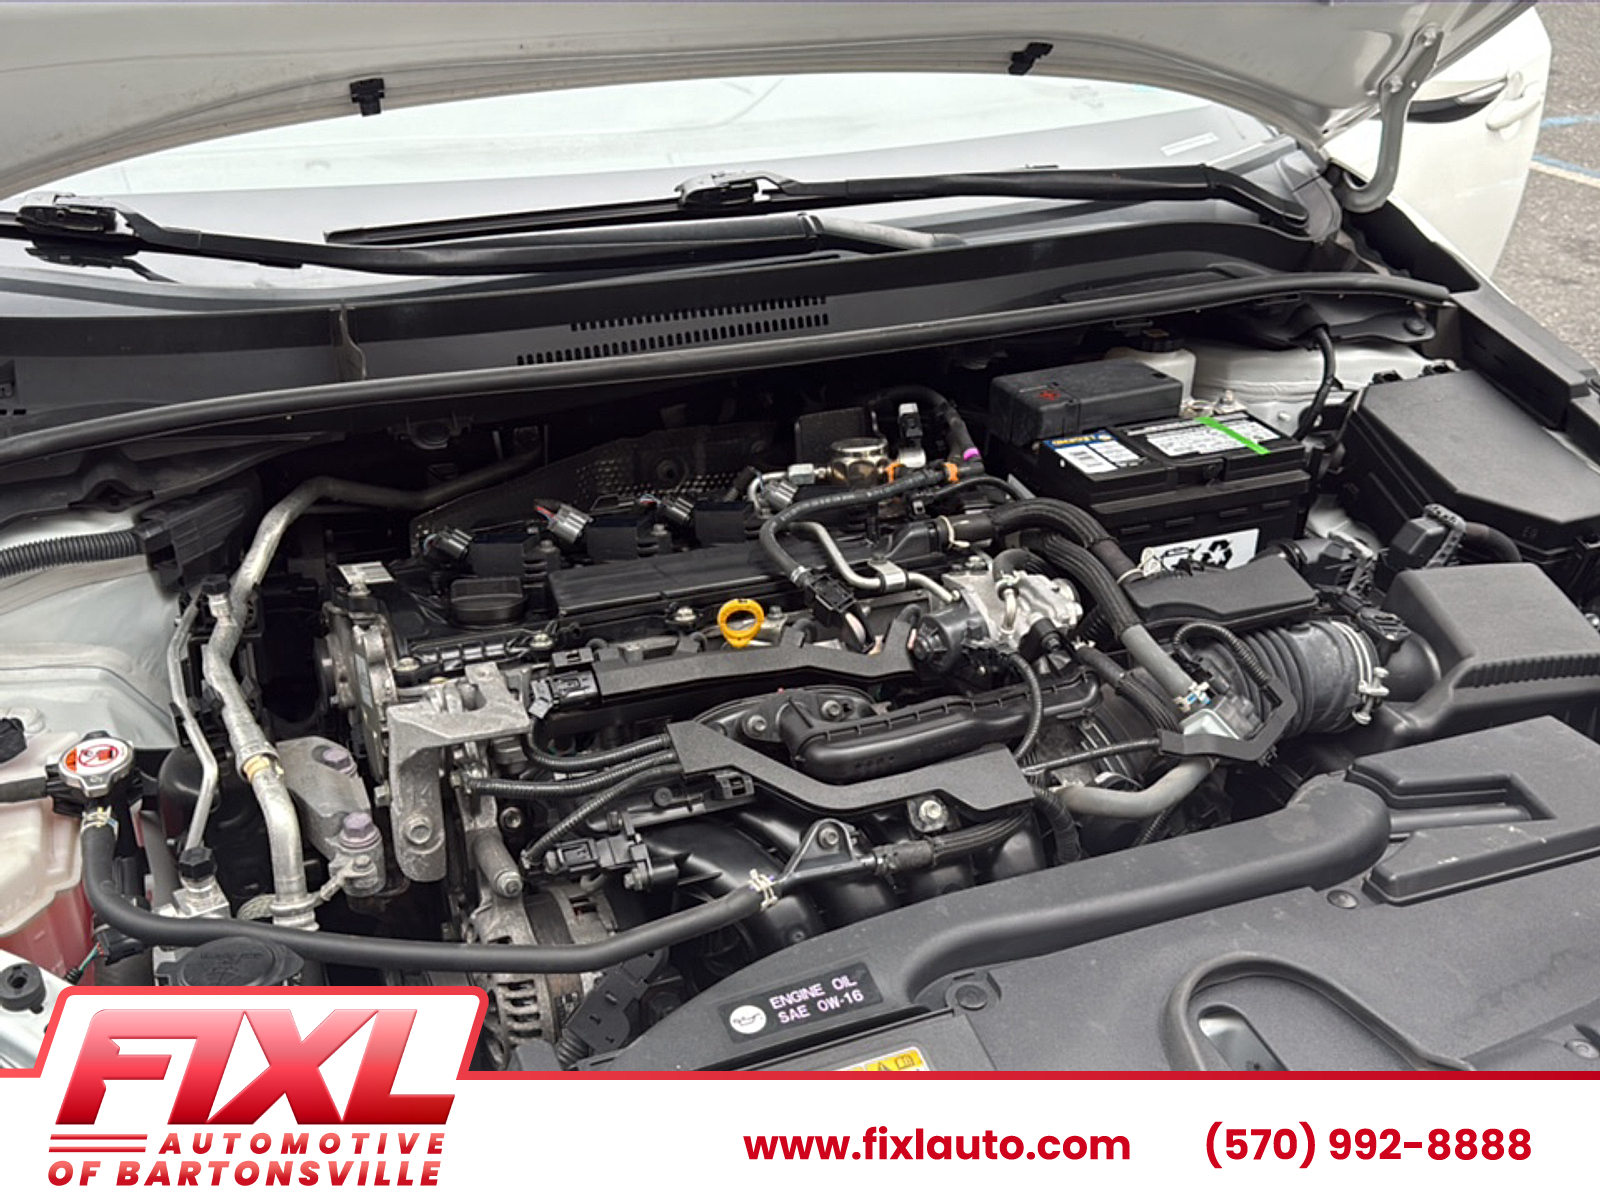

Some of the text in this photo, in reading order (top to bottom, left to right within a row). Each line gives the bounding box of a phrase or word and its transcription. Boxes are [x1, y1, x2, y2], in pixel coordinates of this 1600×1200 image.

[769, 975, 858, 1010] ENGINE OIL
[778, 989, 864, 1024] SAE 0W-16
